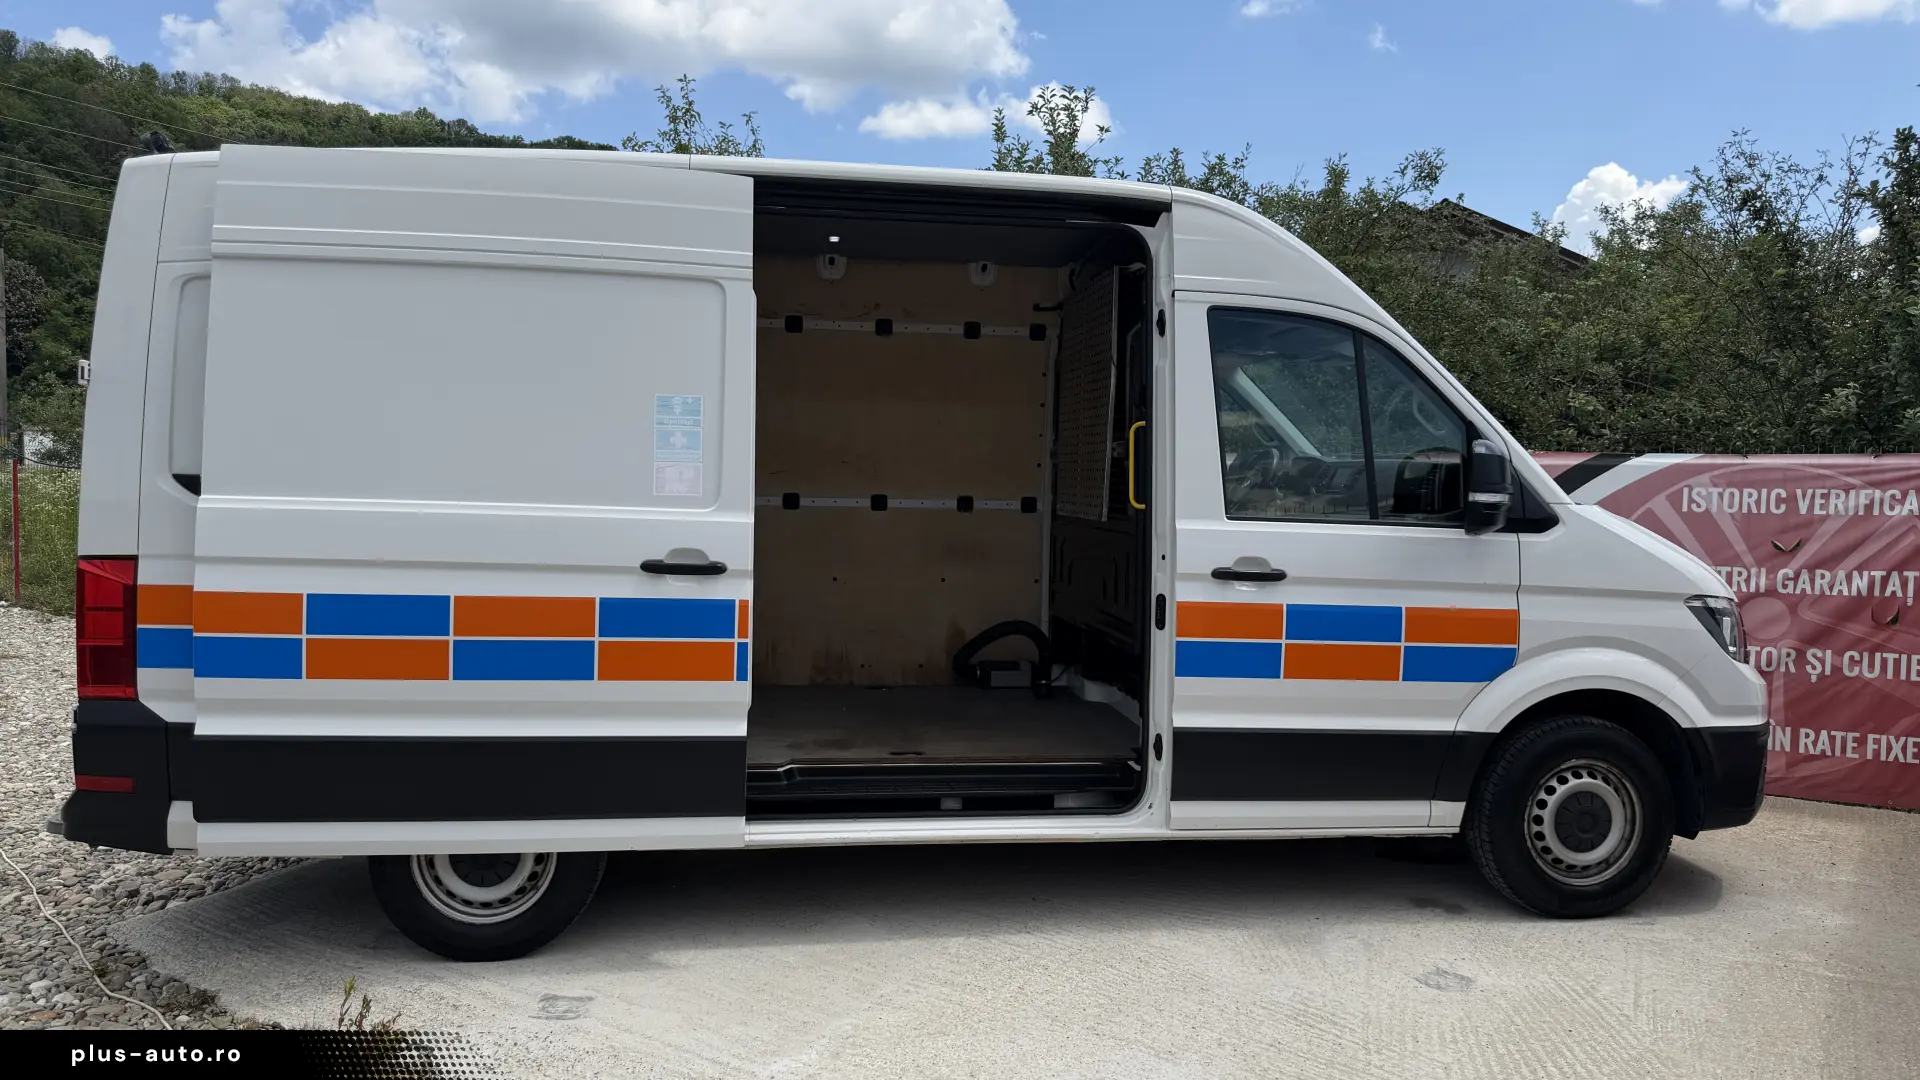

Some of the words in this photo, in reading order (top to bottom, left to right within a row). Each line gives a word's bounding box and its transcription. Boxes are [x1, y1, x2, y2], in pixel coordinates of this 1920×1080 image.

[1682, 487, 1787, 514] ISTORIC
[1796, 489, 1920, 516] VERIFICA
[1711, 566, 1767, 594] TRII
[1777, 568, 1920, 606] GARANTAȚ
[1805, 648, 1832, 683] ȘI
[1842, 650, 1920, 682] CUTIE
[1799, 728, 1860, 759] RATE
[1866, 734, 1920, 764] FIXE
